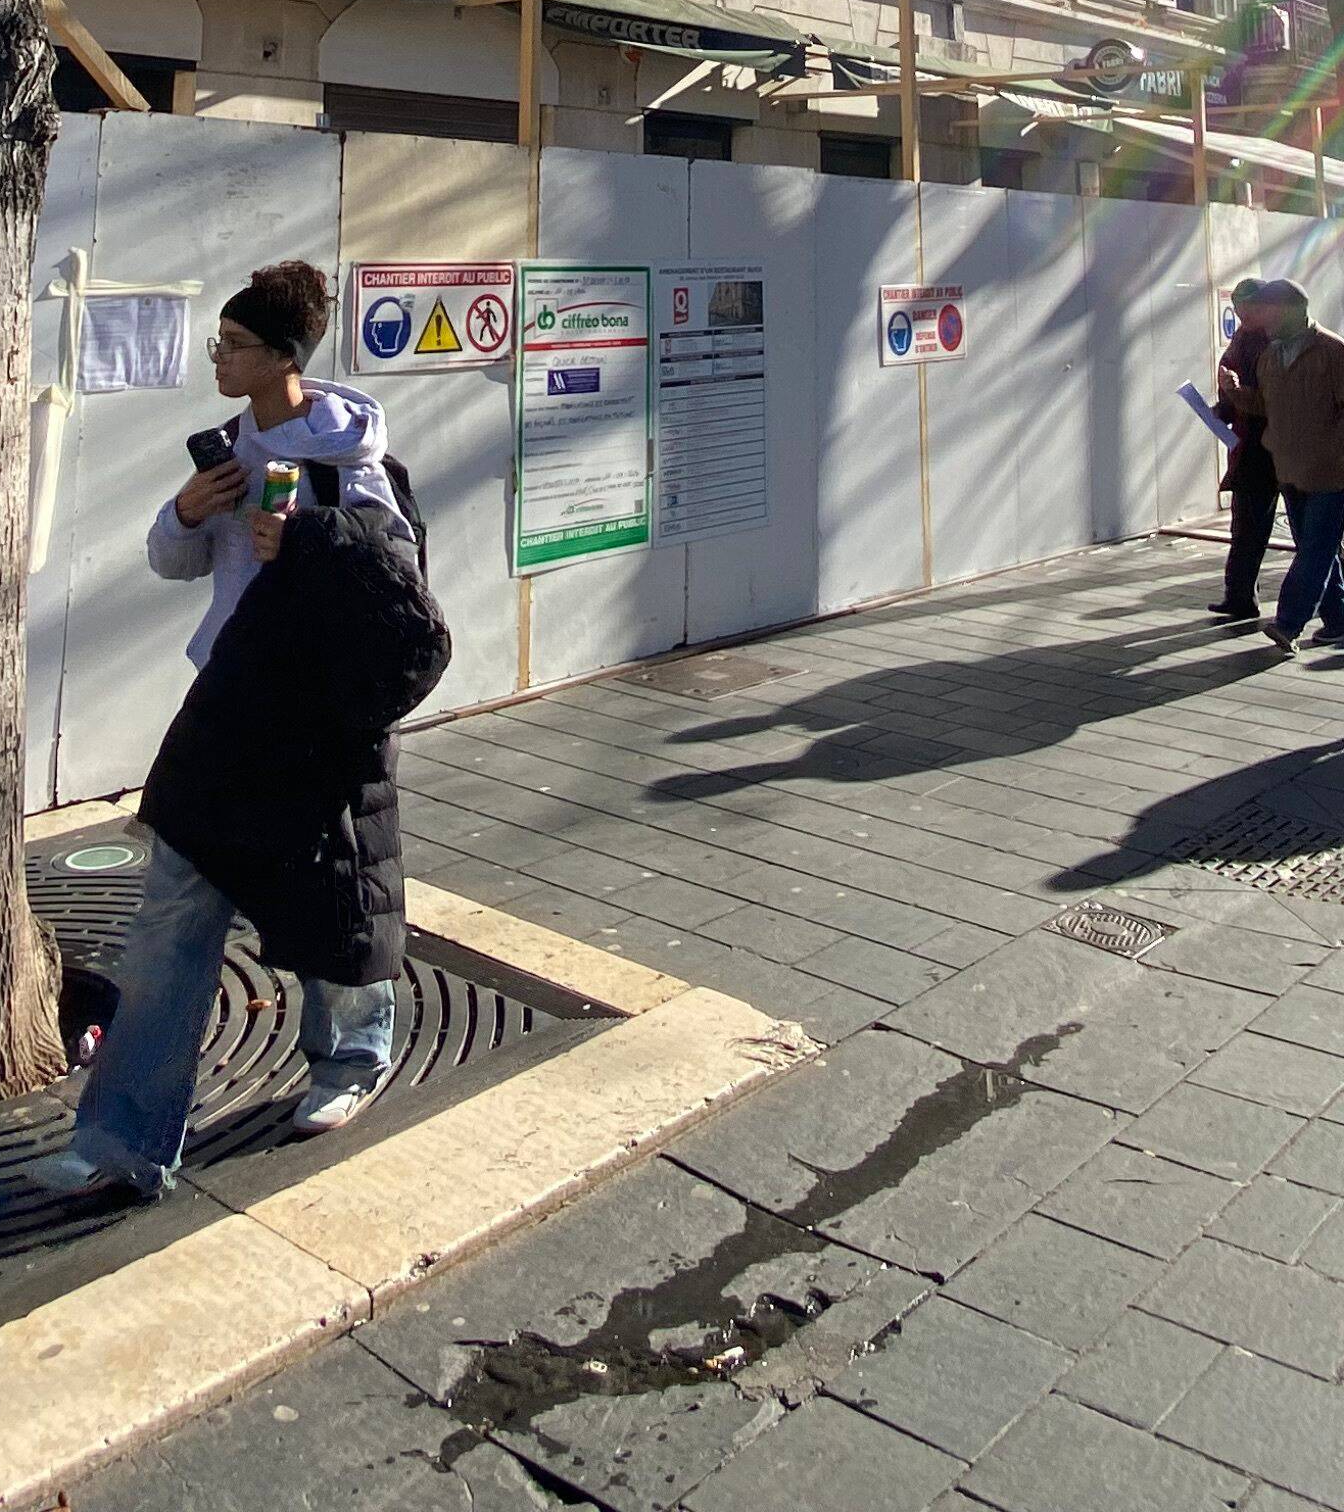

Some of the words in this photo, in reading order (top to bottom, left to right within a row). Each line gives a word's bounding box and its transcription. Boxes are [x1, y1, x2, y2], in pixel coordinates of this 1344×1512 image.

[364, 273, 416, 285] CHANTIER
[417, 272, 459, 285] INTERDIT
[462, 272, 475, 284] AU
[477, 271, 511, 284] PUBLIC
[601, 313, 629, 328] bona
[520, 532, 563, 548] CHANTIER
[564, 524, 603, 539] INTERDIT
[605, 521, 617, 532] AU
